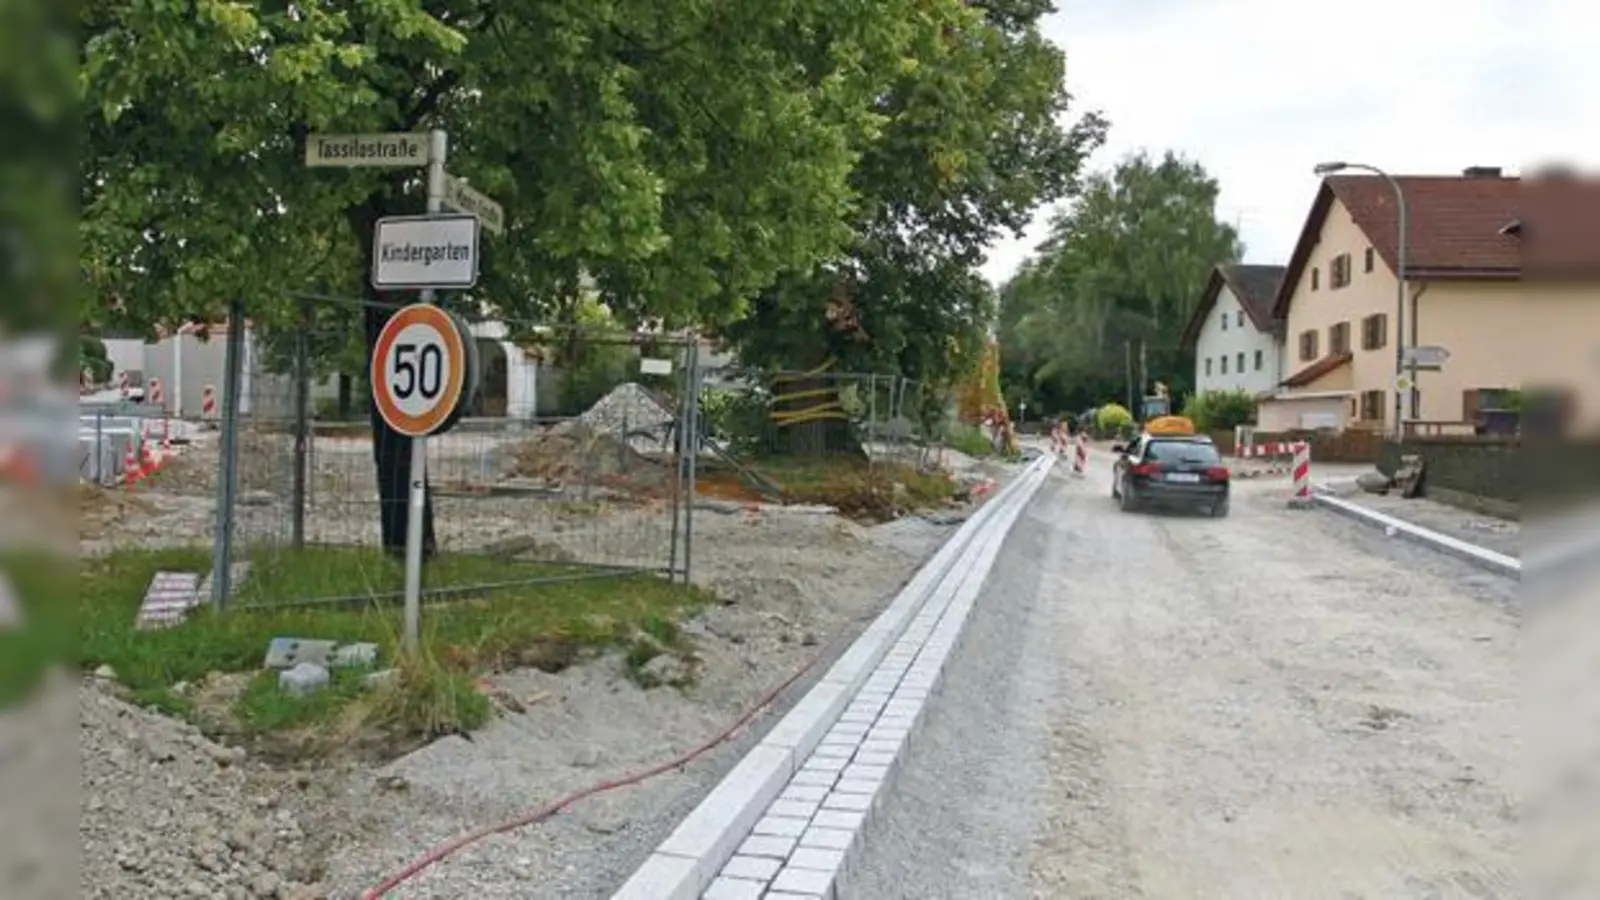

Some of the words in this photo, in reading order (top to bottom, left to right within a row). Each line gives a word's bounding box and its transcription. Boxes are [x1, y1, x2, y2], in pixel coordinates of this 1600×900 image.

[318, 138, 418, 159] Tassilostraße
[380, 242, 469, 267] Kindergarten
[393, 343, 442, 400] 50
